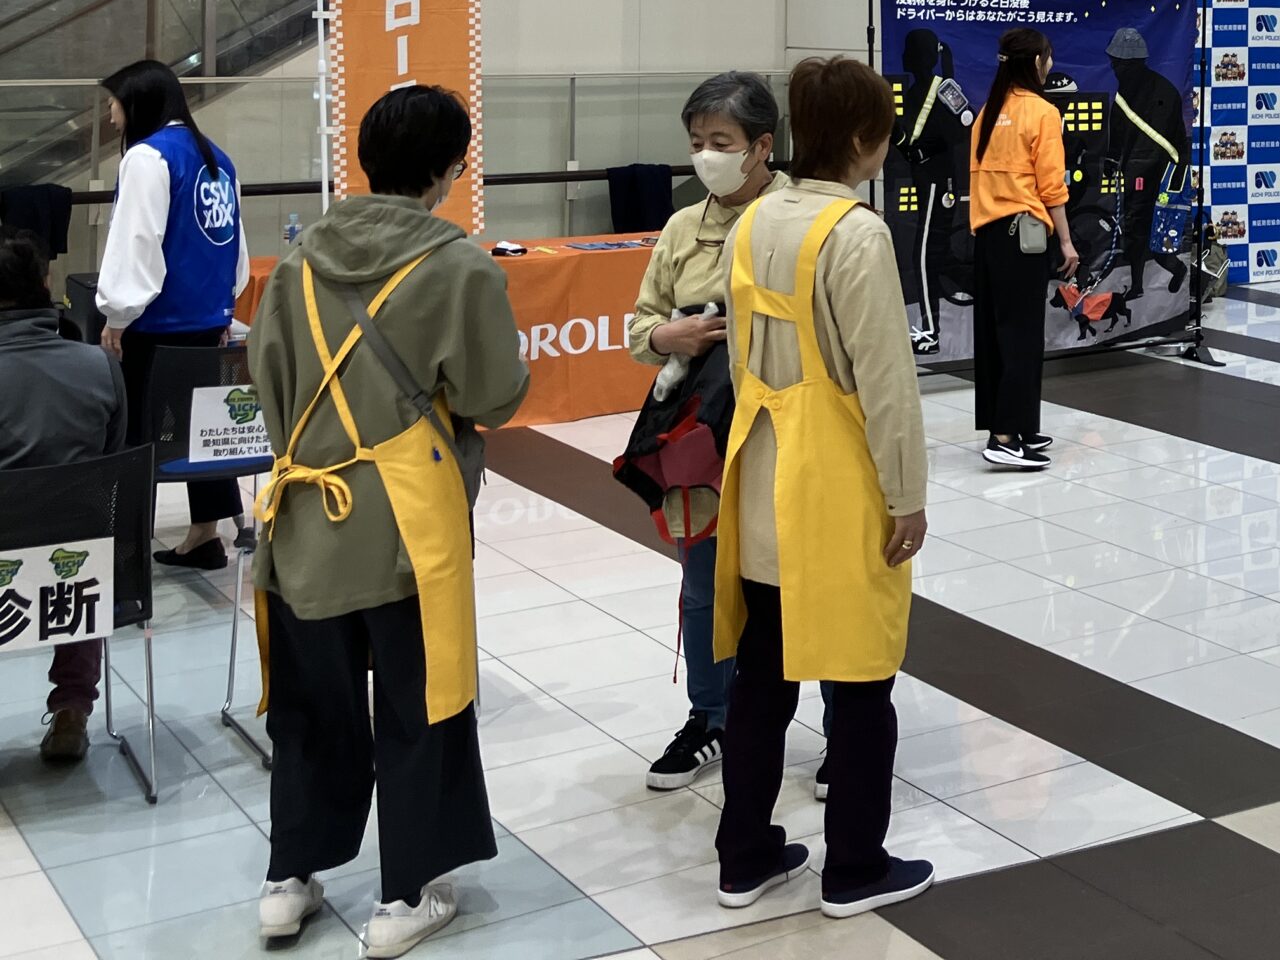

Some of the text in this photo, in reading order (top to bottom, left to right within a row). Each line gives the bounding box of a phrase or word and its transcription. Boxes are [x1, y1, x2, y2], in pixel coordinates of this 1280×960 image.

[896, 9, 1078, 23] ドライバーからはあなたがこう見えます。
[200, 181, 229, 206] CSV
